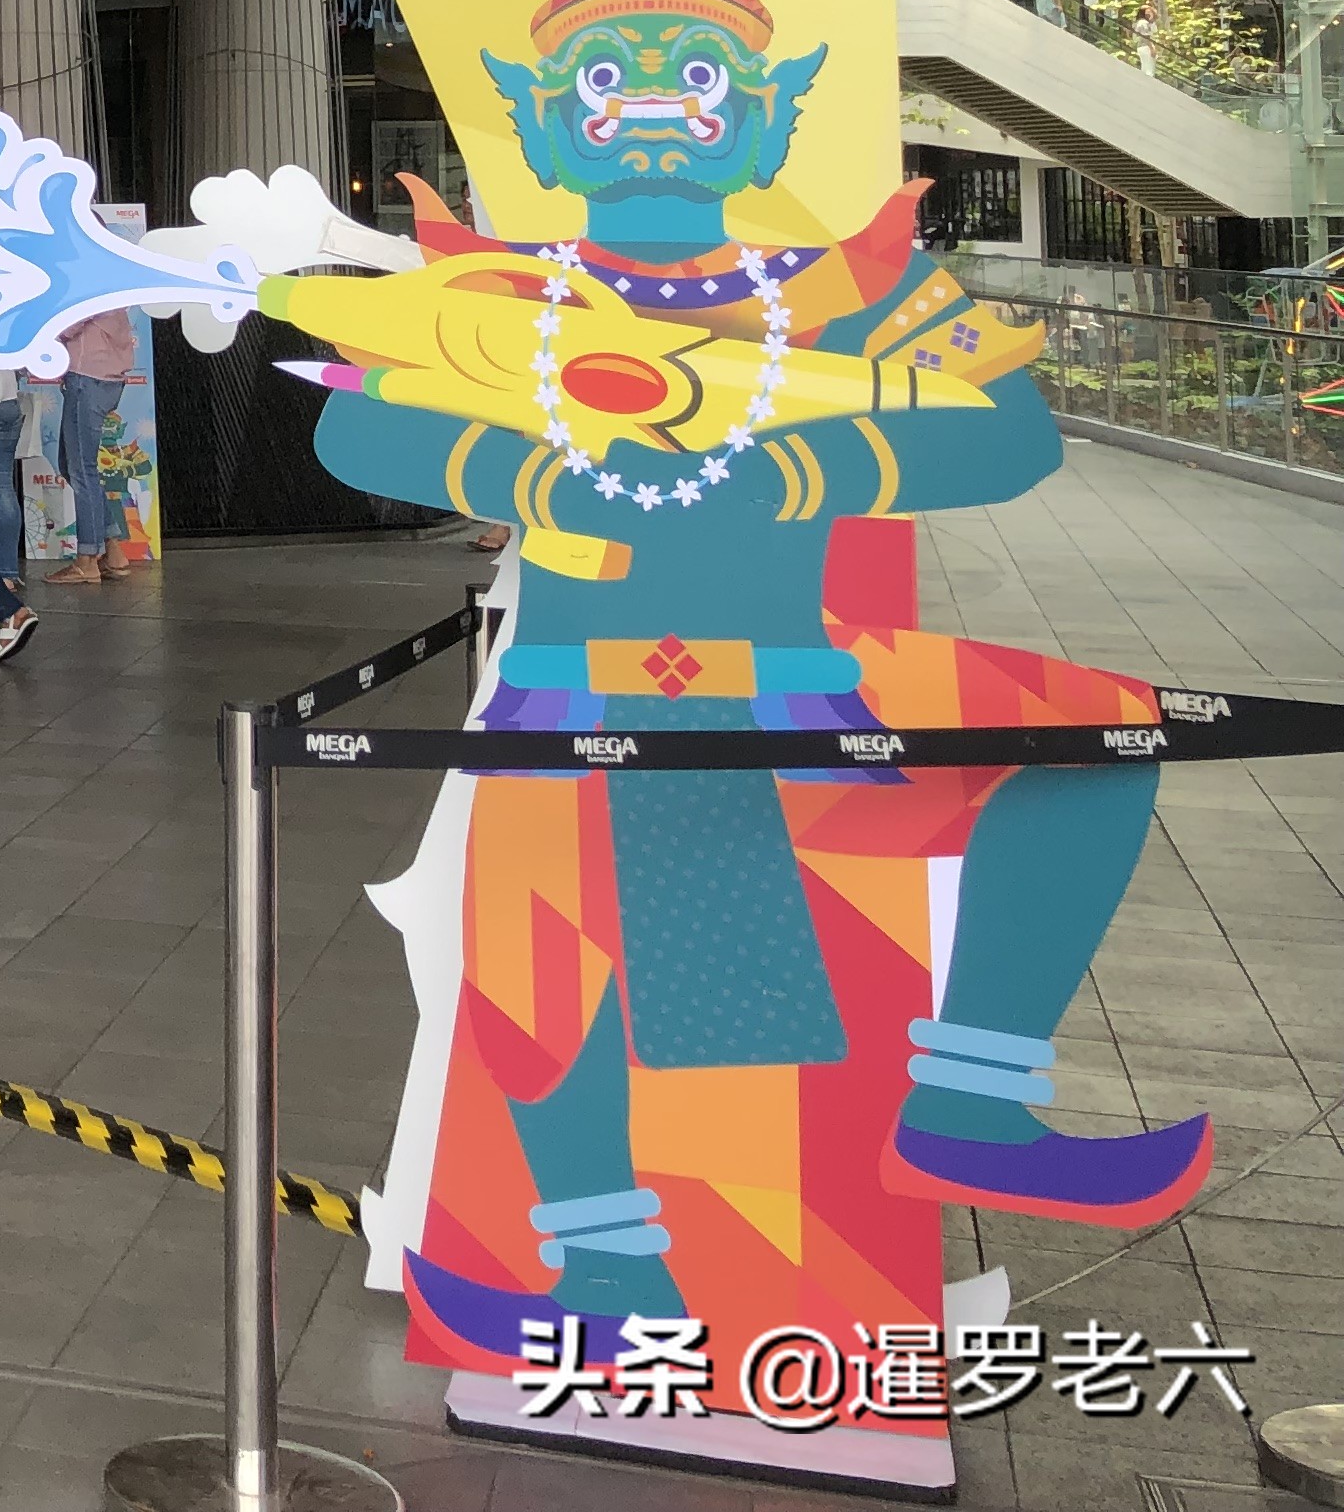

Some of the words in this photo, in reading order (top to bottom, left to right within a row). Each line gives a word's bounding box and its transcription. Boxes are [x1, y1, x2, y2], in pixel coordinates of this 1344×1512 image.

[116, 209, 140, 219] MEGA
[32, 474, 67, 488] MEG
[1160, 691, 1232, 722] MEGA
[306, 734, 372, 761] MEGA
[574, 737, 638, 761] MEGA
[839, 734, 906, 761] MEGA
[1103, 729, 1169, 755] MEGA
